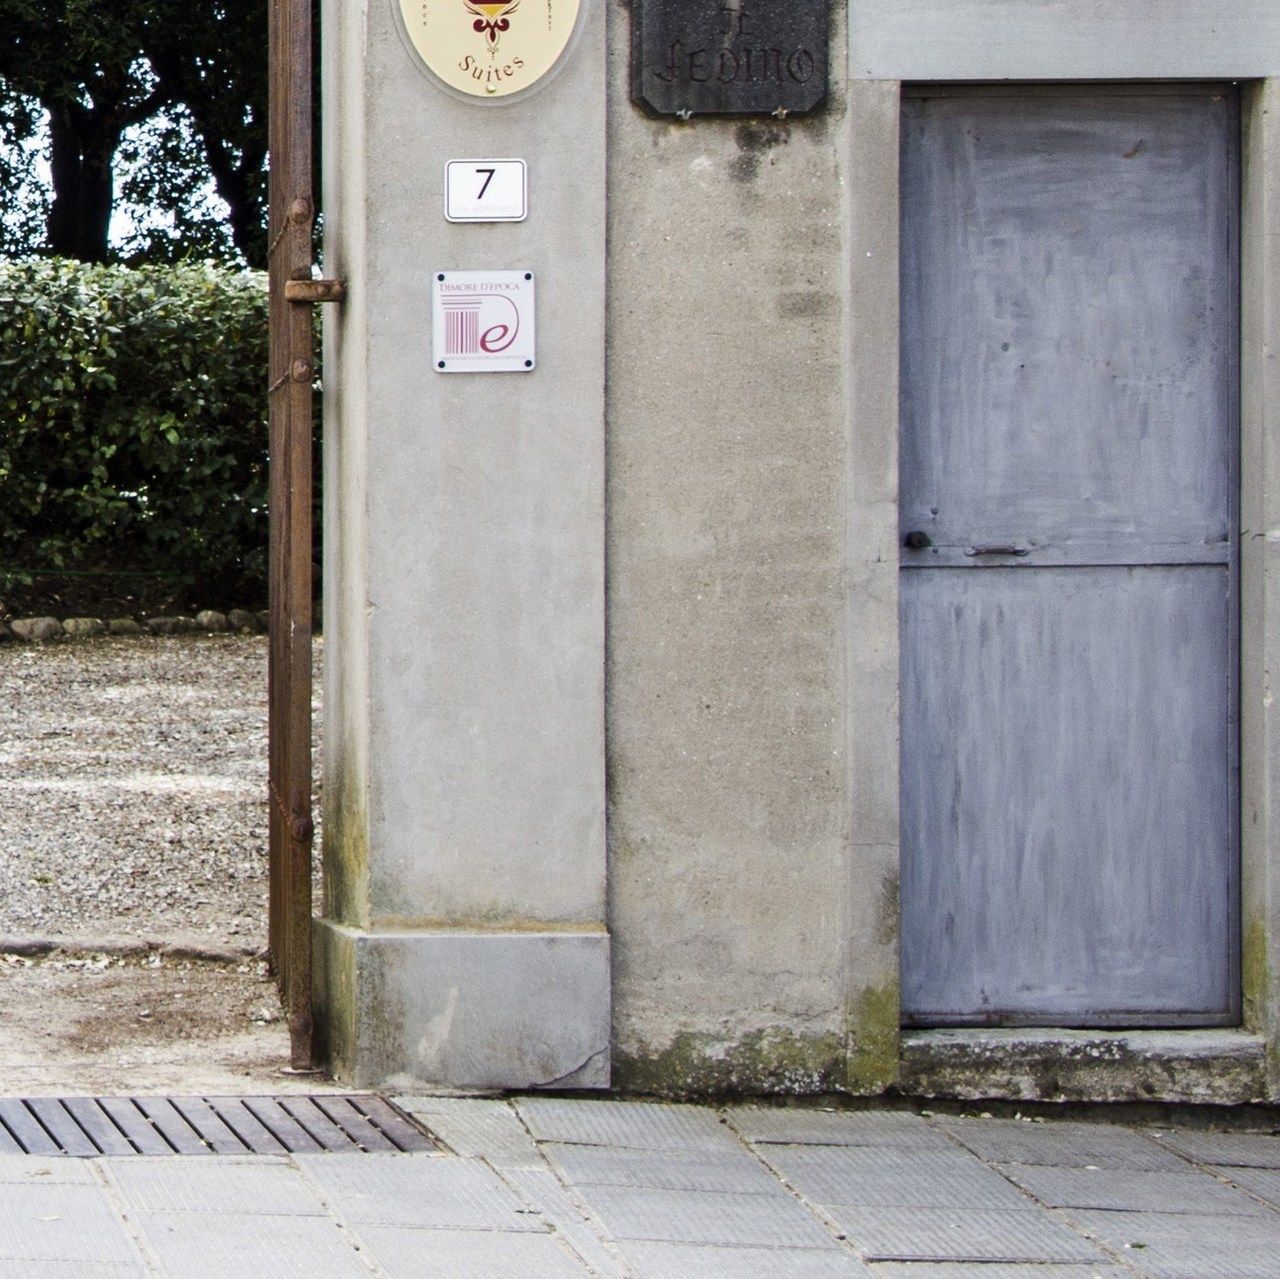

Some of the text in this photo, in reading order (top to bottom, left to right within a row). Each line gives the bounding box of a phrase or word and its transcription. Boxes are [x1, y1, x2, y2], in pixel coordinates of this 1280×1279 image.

[457, 55, 525, 83] Suites
[475, 168, 496, 200] 7
[439, 283, 478, 293] DIMORE
